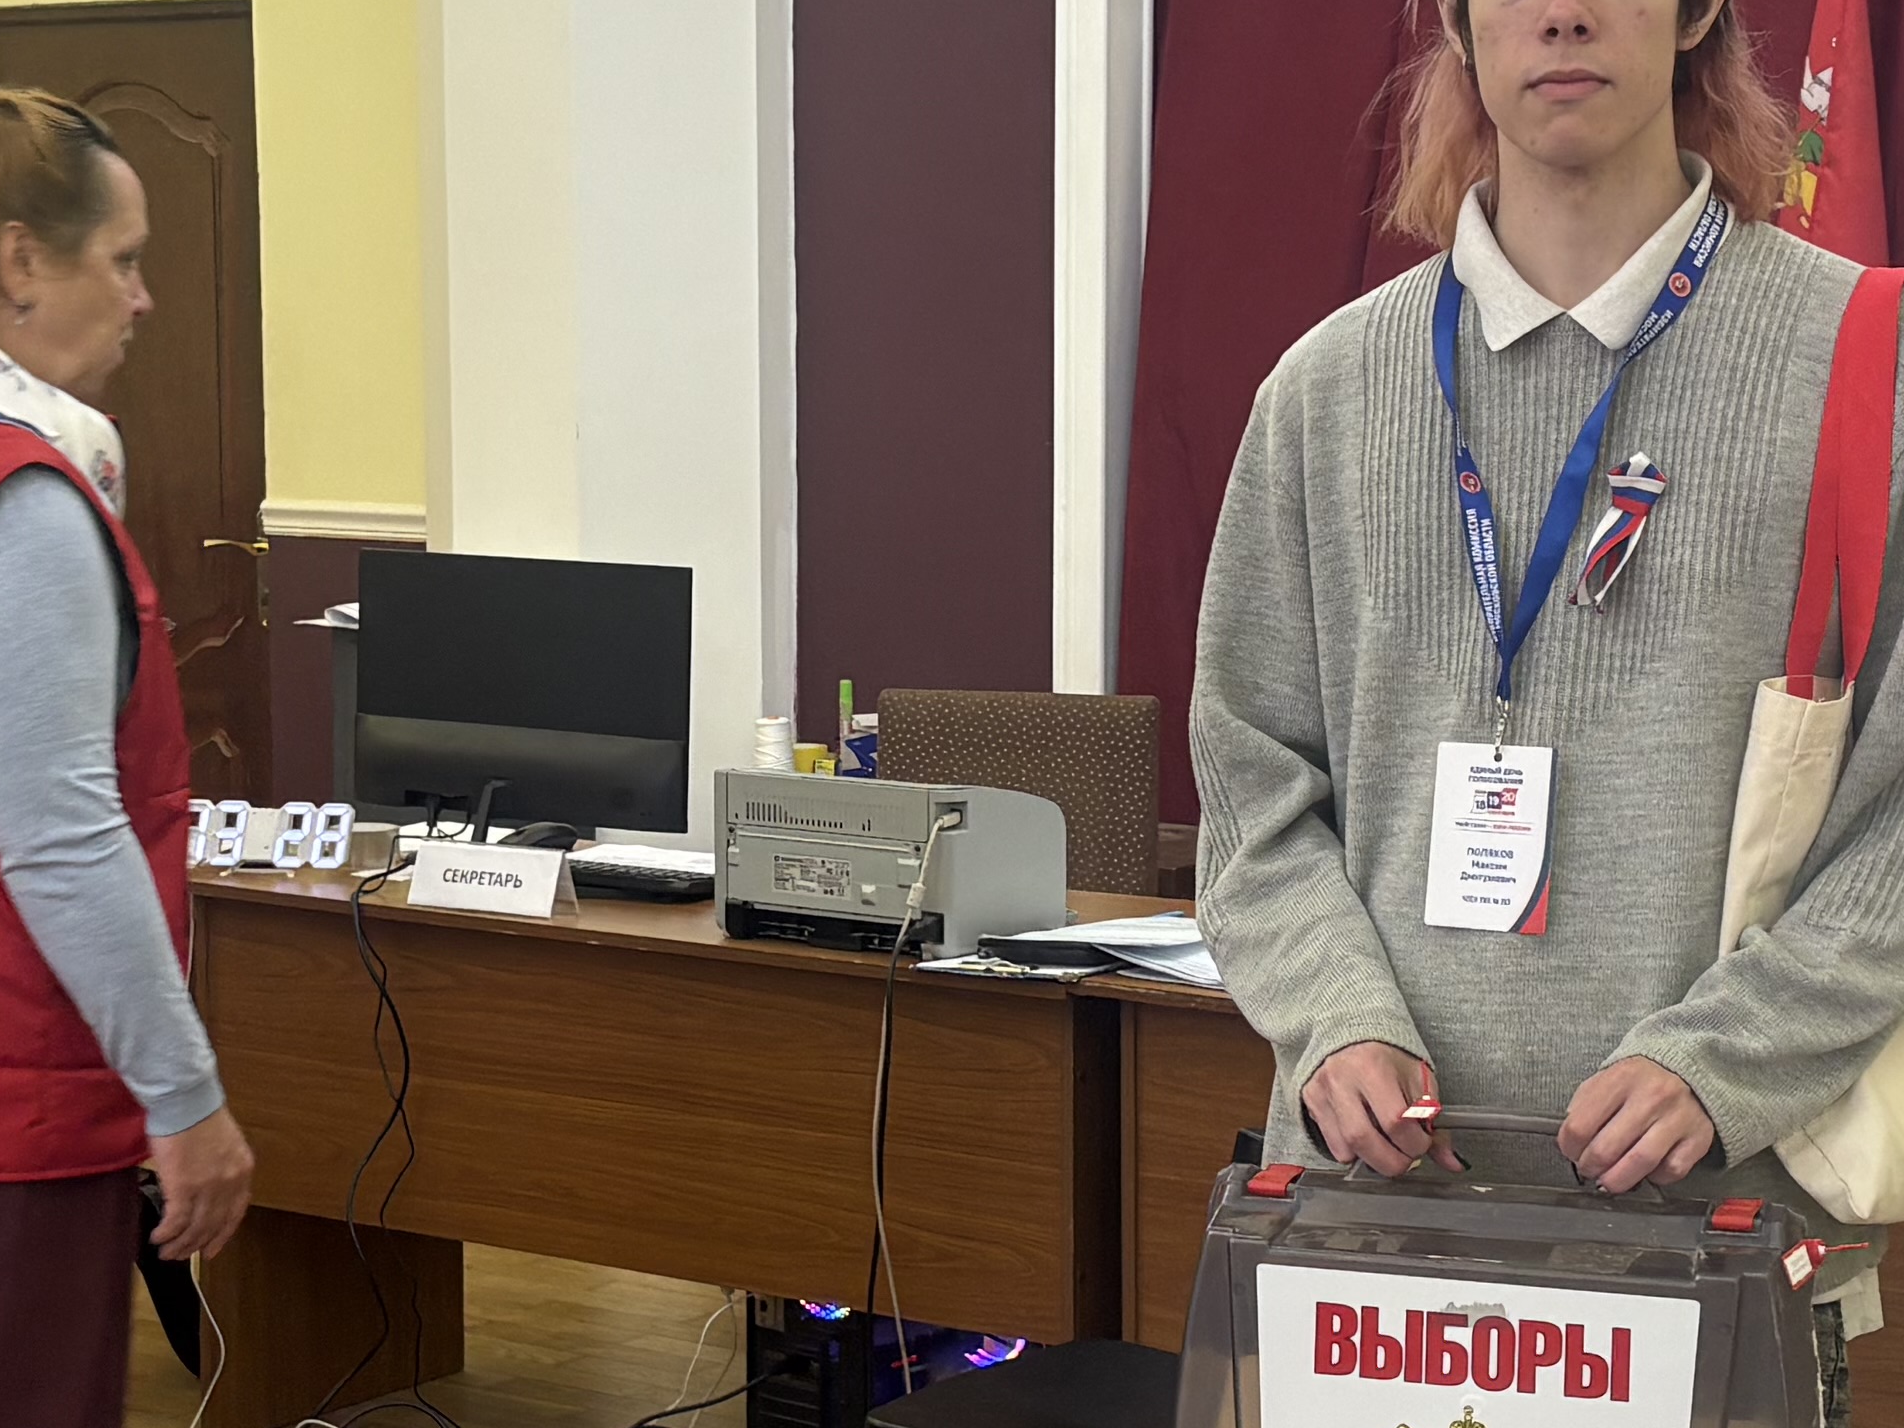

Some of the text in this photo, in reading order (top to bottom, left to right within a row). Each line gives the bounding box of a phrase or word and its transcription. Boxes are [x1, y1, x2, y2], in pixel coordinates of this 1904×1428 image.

[273, 805, 351, 869] 28
[442, 868, 524, 889] СЕКРЕТАРЬ
[1313, 1301, 1632, 1403] ВЫБОРЫ
